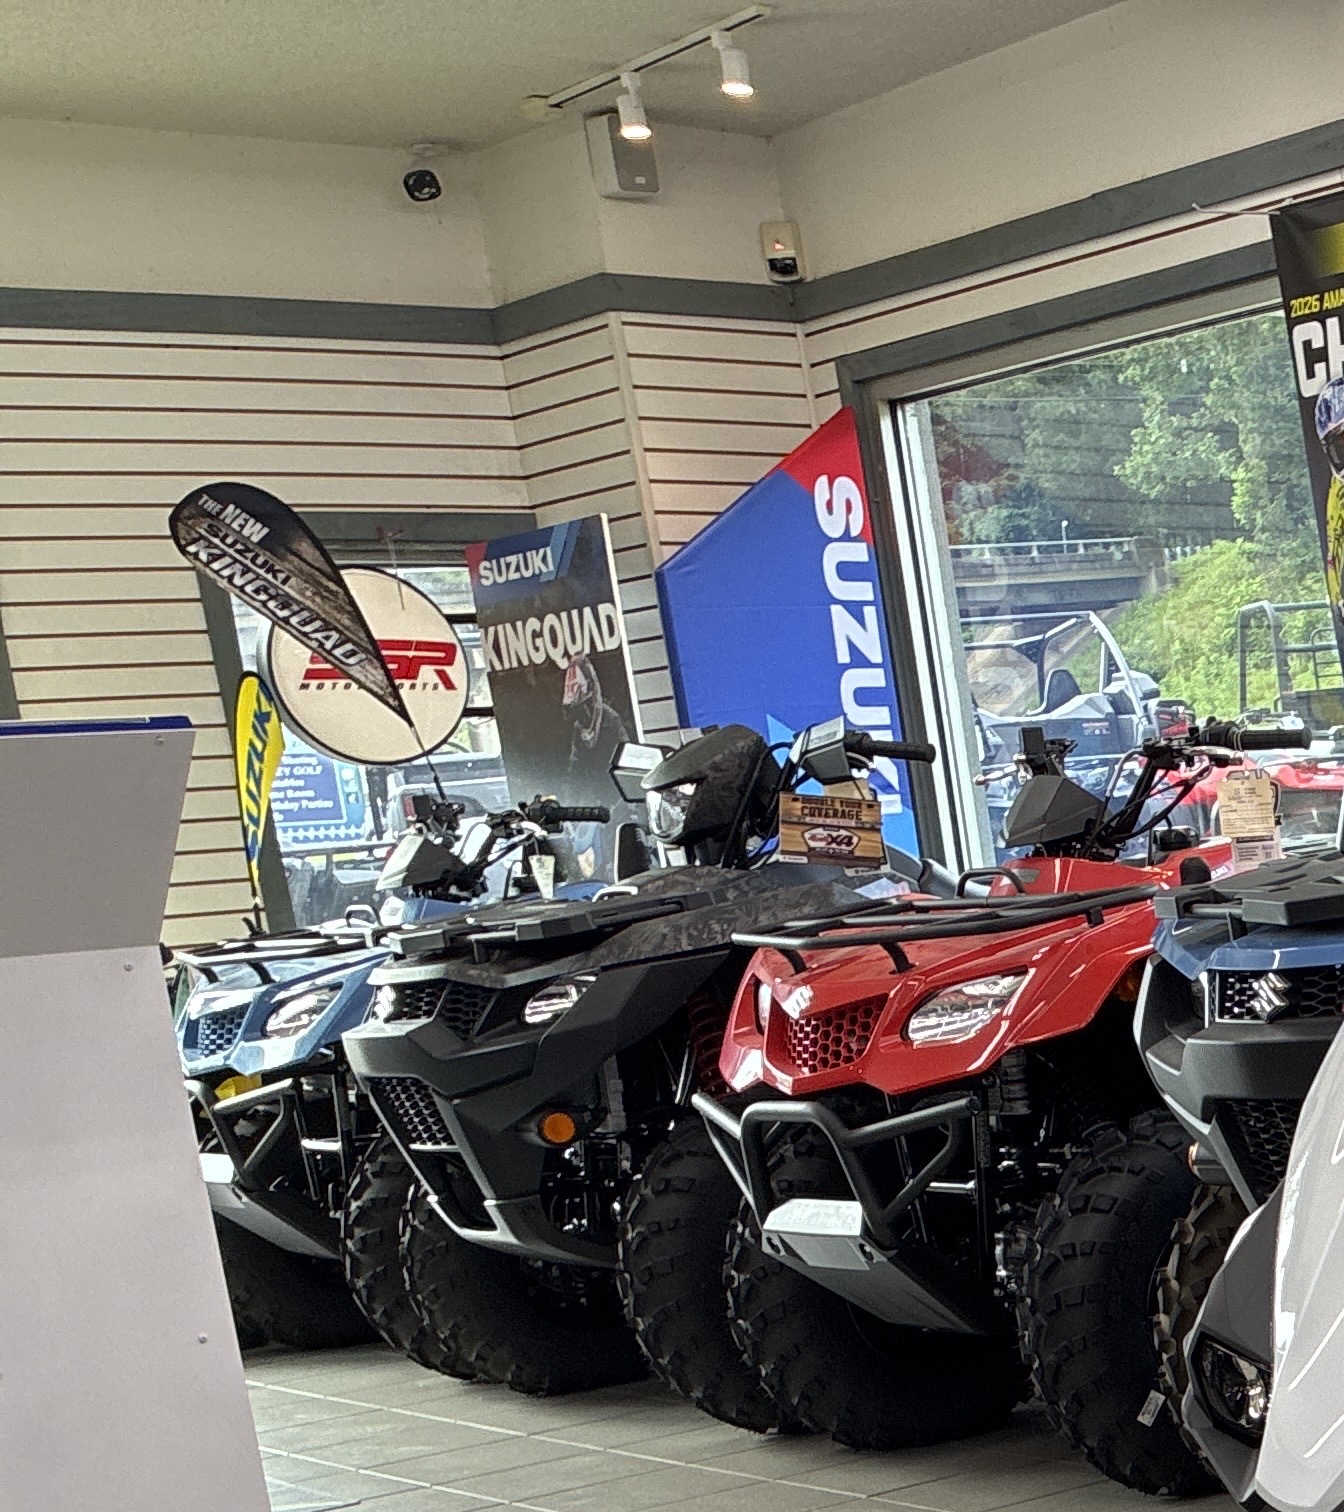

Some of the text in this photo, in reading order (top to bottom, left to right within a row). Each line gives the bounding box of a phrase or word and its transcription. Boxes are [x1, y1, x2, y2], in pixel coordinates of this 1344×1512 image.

[198, 493, 270, 545] THE NEW
[200, 522, 294, 588] SUZUKI
[478, 546, 555, 587] SUZUKI
[185, 537, 369, 667] KINGQUAD
[480, 602, 622, 670] KINGQUAD
[801, 805, 863, 821] COVERAGE
